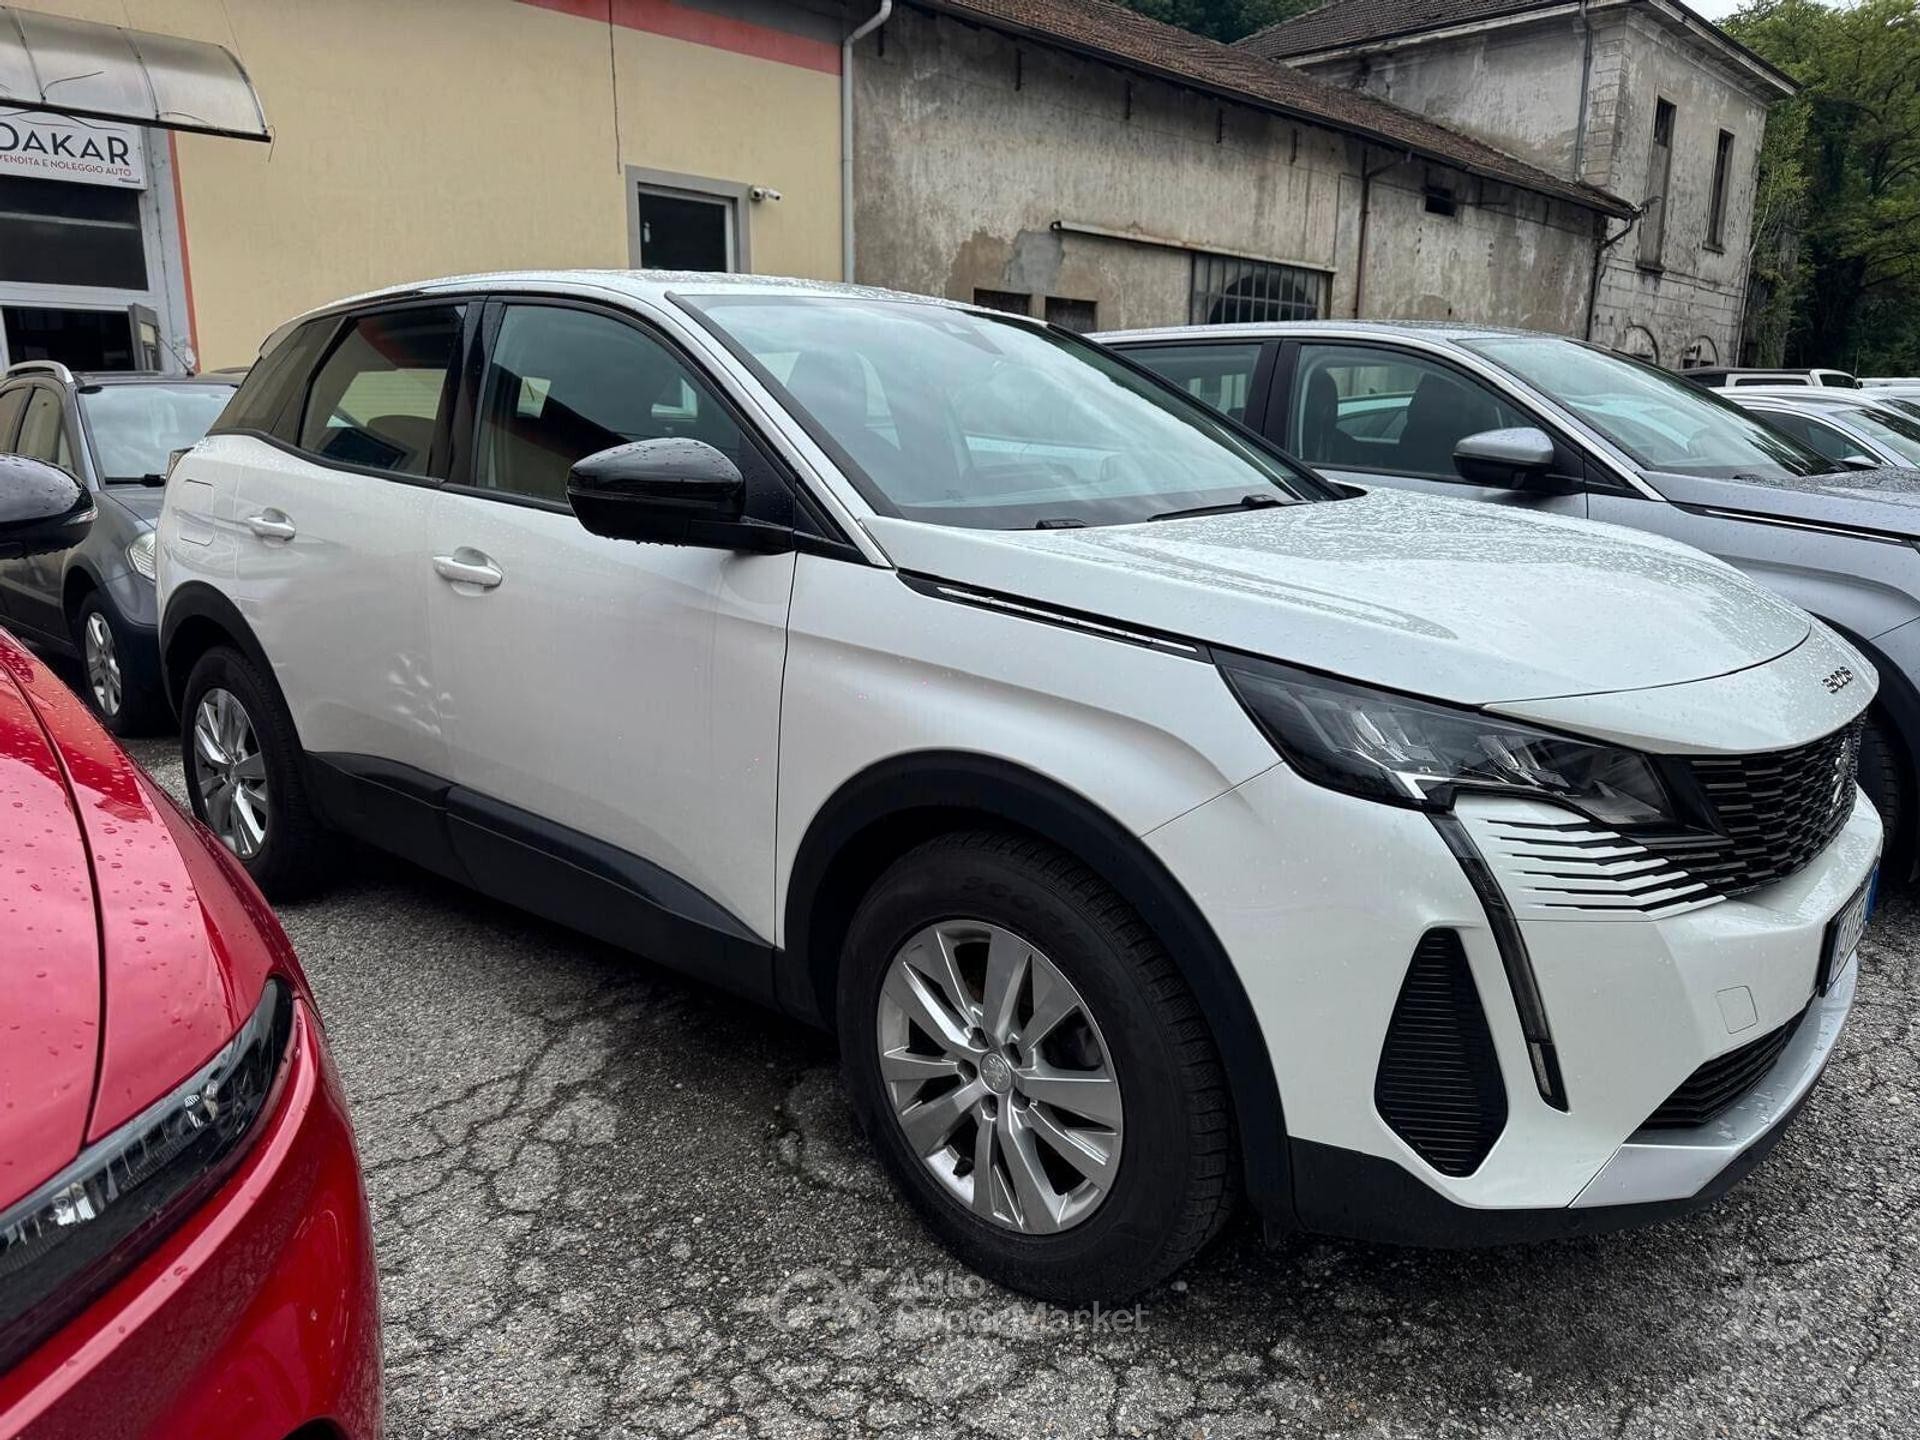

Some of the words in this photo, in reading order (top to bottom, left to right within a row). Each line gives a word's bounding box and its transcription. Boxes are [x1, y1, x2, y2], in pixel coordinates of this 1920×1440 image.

[0, 122, 129, 166] DAKAR
[42, 158, 49, 167] E
[50, 159, 104, 174] NOLEGGIO
[105, 168, 132, 177] AUTO
